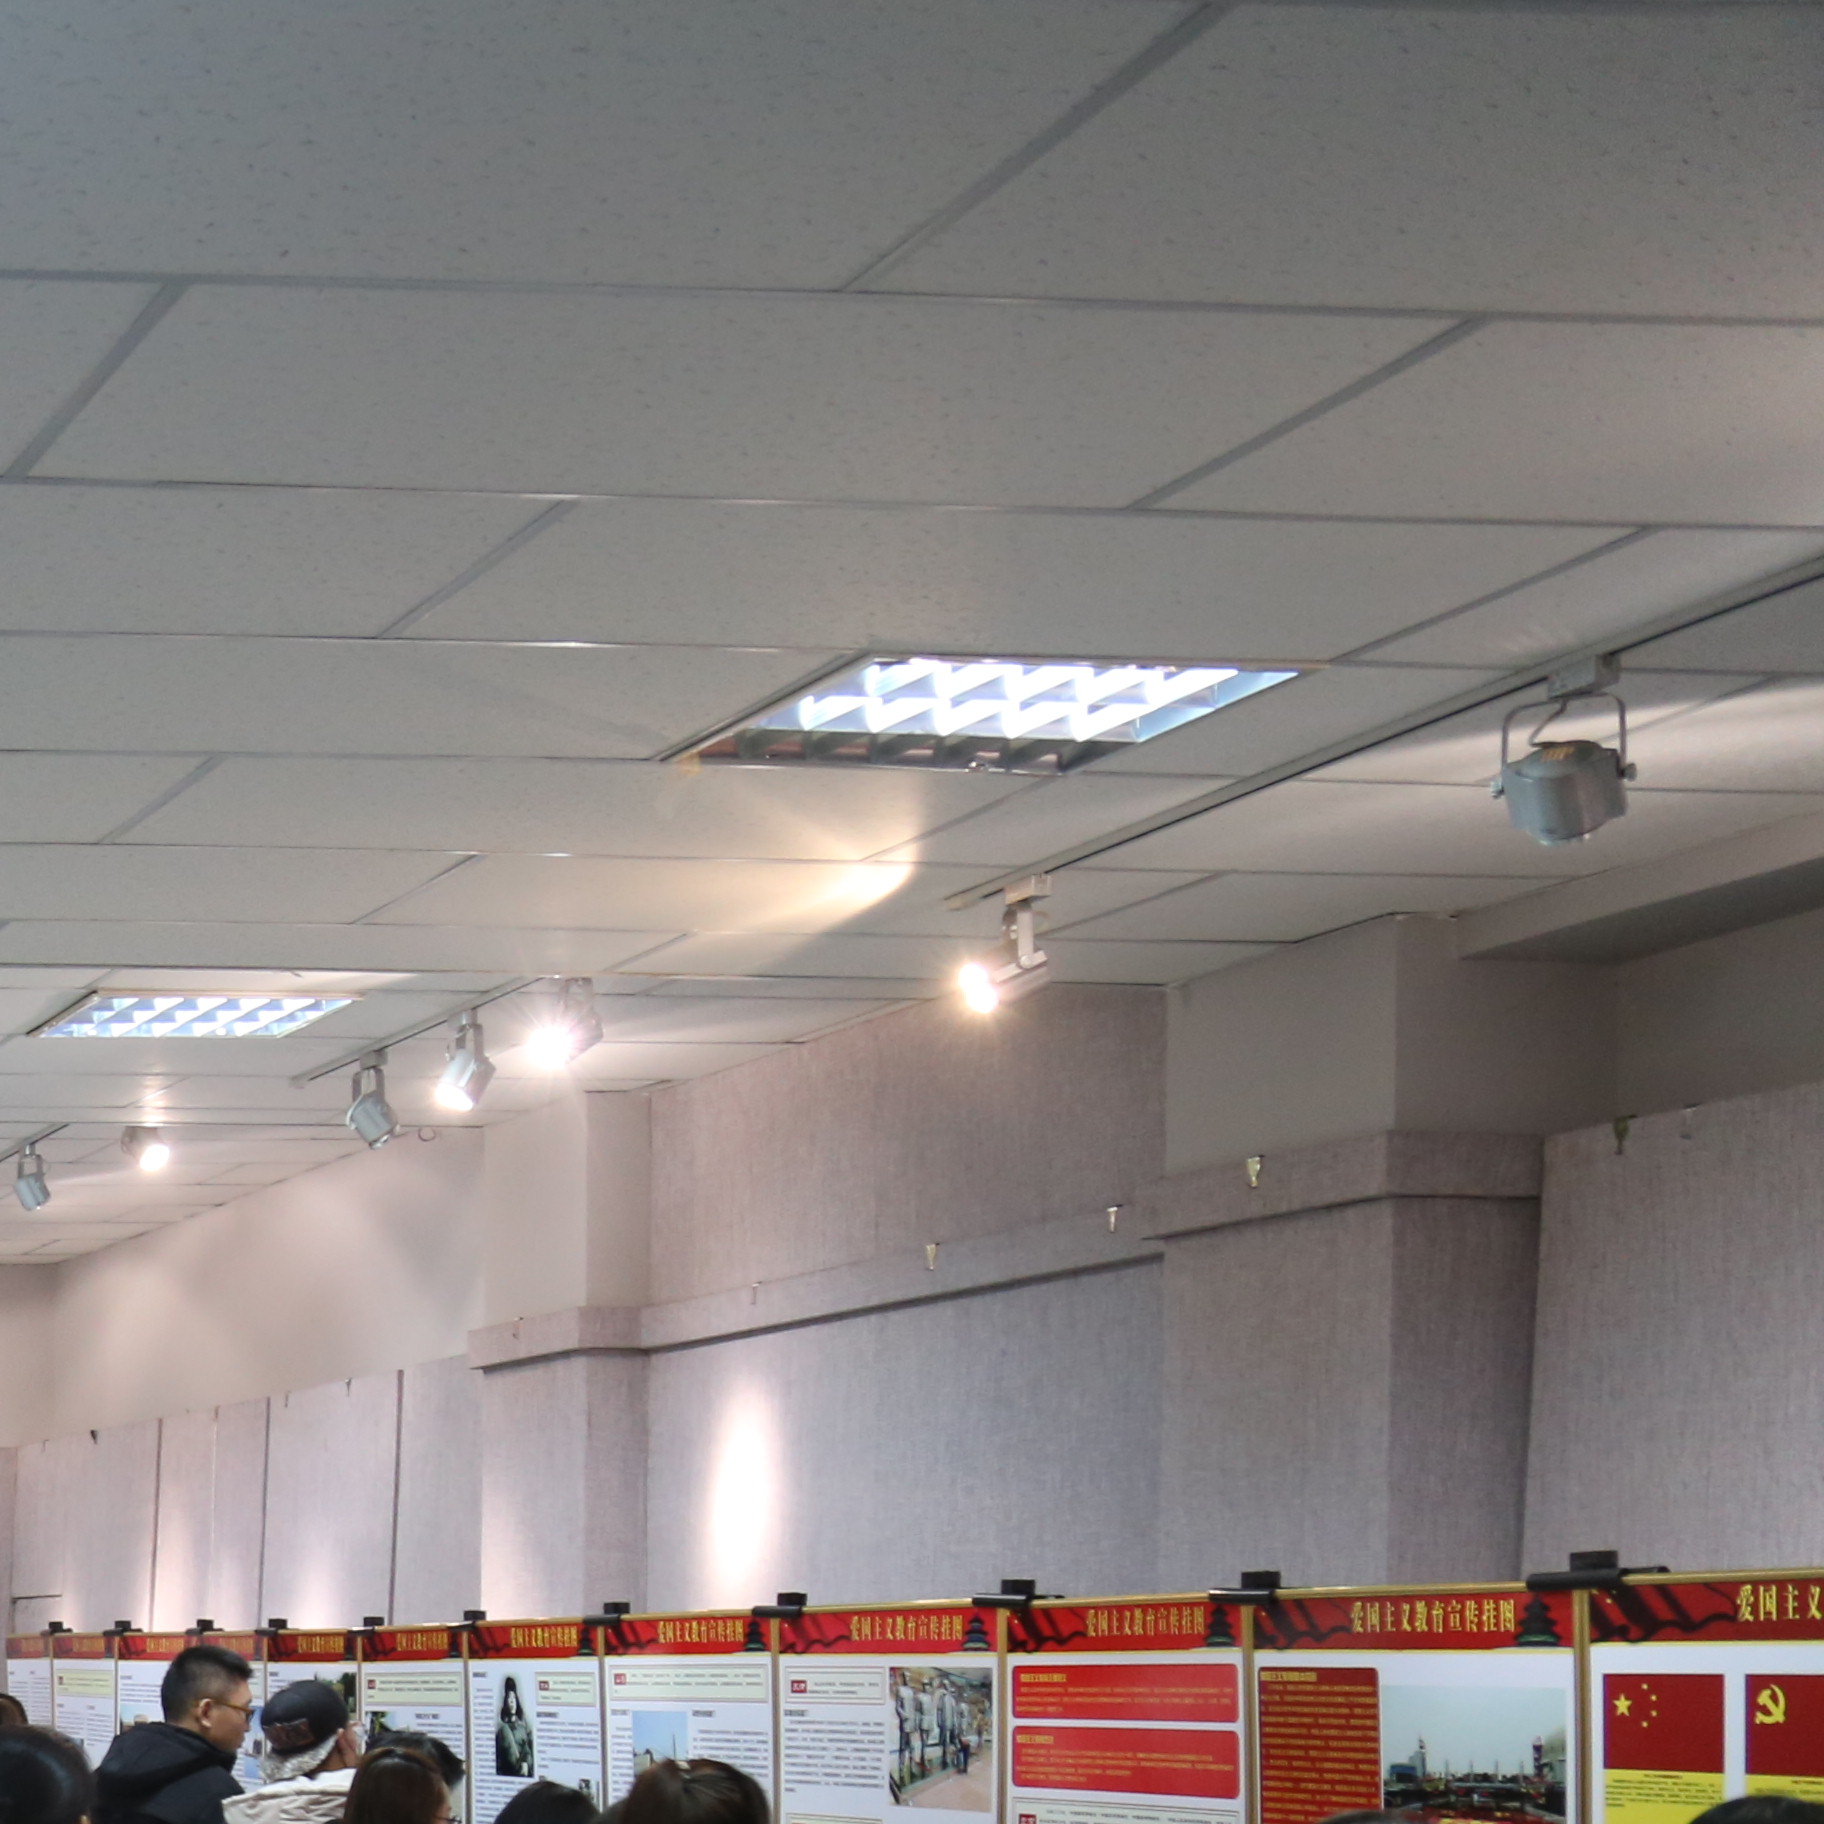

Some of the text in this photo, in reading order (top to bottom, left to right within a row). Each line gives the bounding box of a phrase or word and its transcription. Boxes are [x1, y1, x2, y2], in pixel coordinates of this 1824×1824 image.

[1351, 1600, 1515, 1633] 爱国主义教育宣传挂图
[1737, 1584, 1824, 1622] 爱国主义
[657, 1620, 744, 1643] 爱国主义教育宣传挂图
[850, 1615, 963, 1641] 爱国主义教育宣传挂图
[1086, 1606, 1204, 1637] 爱国主义教育宣传挂图
